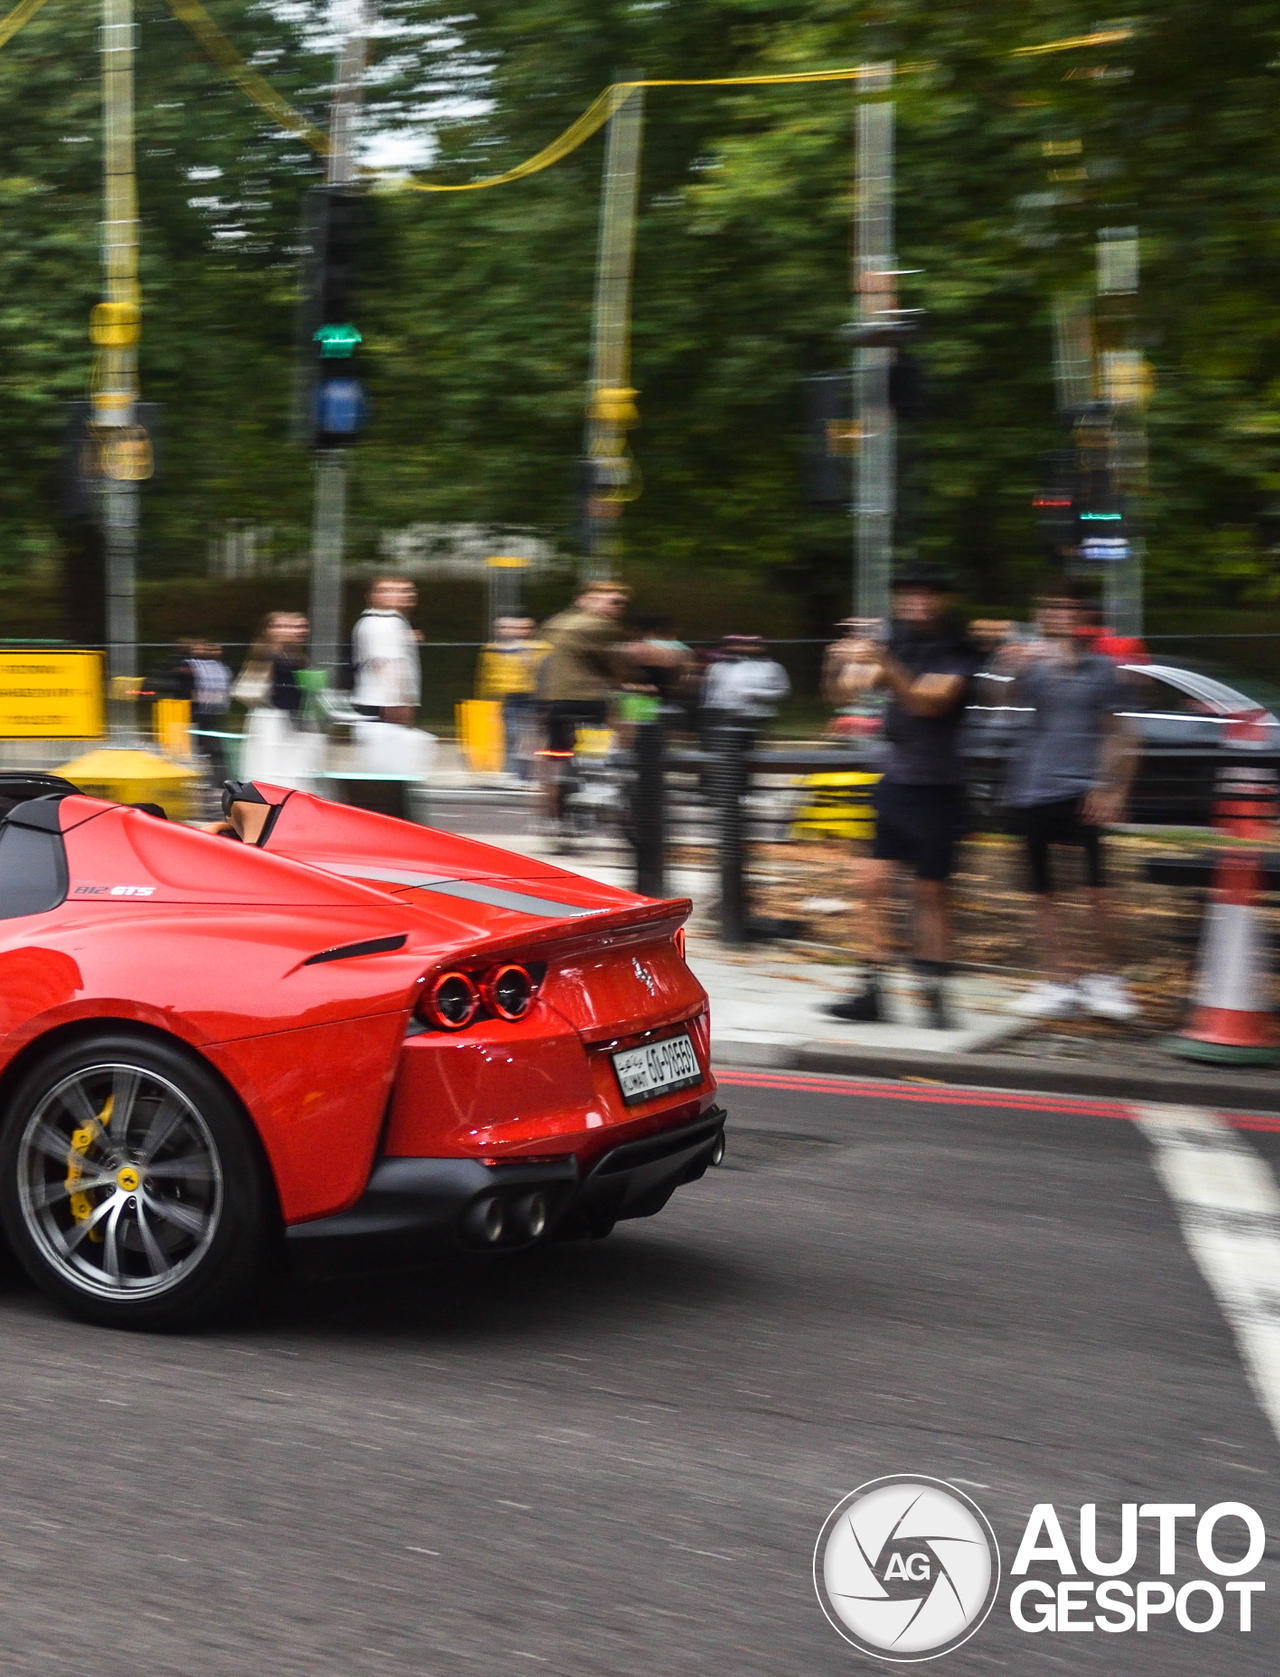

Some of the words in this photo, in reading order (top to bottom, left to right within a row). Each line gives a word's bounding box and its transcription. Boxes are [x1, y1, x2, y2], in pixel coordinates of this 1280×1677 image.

[74, 886, 108, 895] 812
[109, 886, 156, 896] GTS
[621, 1070, 649, 1092] KUWAIT
